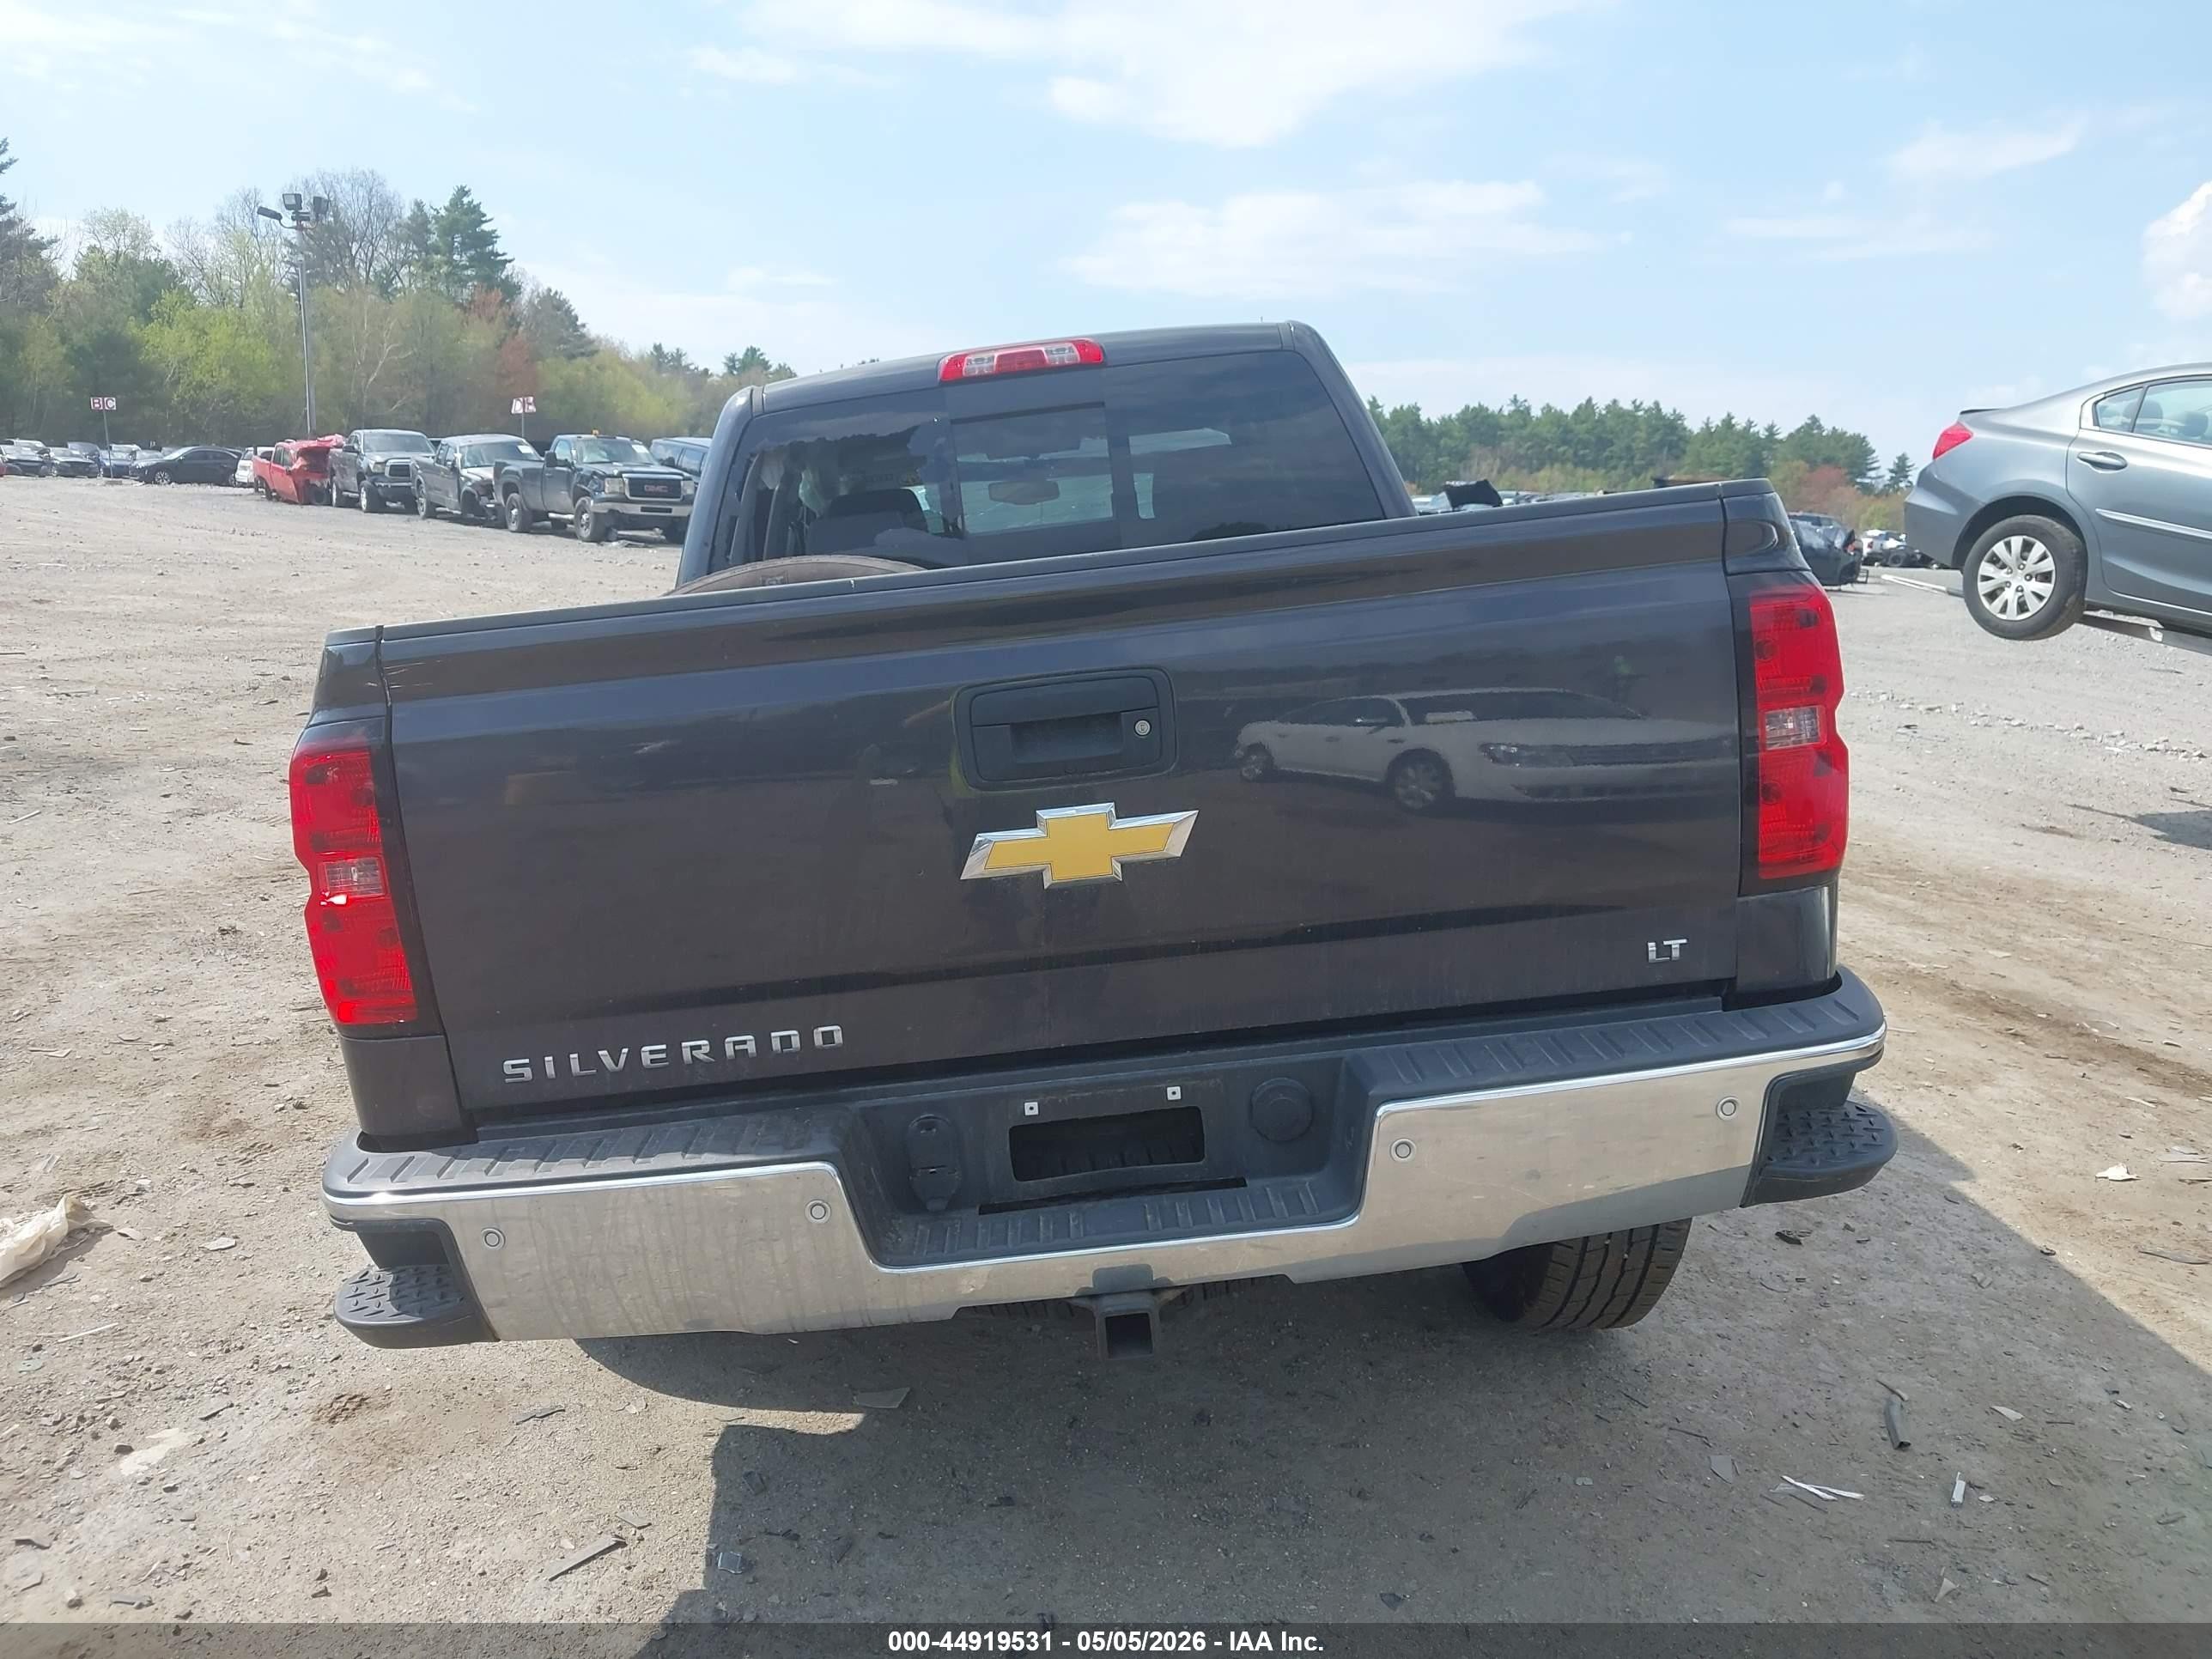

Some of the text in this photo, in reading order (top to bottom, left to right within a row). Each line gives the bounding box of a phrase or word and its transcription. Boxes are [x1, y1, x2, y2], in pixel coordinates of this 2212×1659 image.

[644, 484, 669, 493] GMC
[1648, 939, 1687, 963] LT
[503, 1024, 844, 1084] SILVERADO
